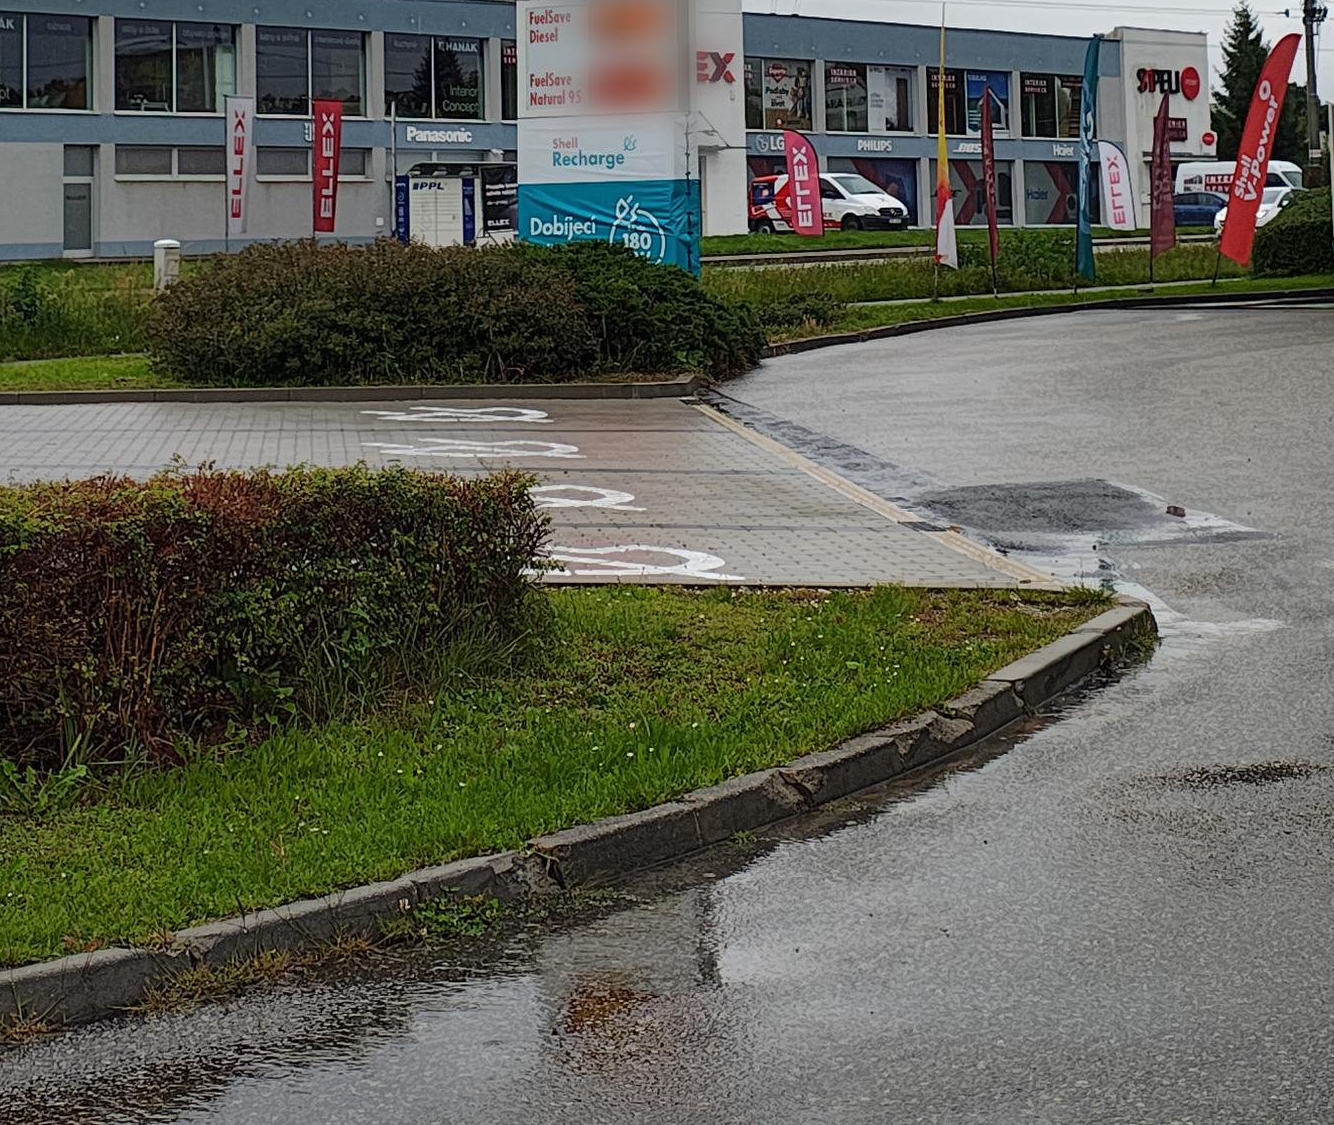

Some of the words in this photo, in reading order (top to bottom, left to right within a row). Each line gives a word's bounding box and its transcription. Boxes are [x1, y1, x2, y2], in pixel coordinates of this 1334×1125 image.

[529, 10, 571, 25] FuelSave
[529, 27, 558, 43] Diesel
[529, 74, 572, 88] FuelSave
[530, 90, 566, 106] Natural
[406, 126, 473, 144] Panasonic
[553, 138, 579, 149] Shell
[771, 137, 785, 151] LG
[858, 140, 892, 151] PHILIPS
[1053, 144, 1073, 156] Haier
[1244, 94, 1279, 202] V-Power
[231, 110, 247, 218] ELLEX
[320, 112, 335, 218] ELLEX
[552, 151, 625, 170] Recharge
[1234, 154, 1252, 199] Shell
[419, 182, 445, 190] PPL
[791, 146, 813, 227] ELLEX
[1027, 188, 1048, 200] Haier
[1108, 155, 1126, 225] ELLEX
[530, 215, 596, 240] Dobíjecí
[623, 232, 652, 250] 180
